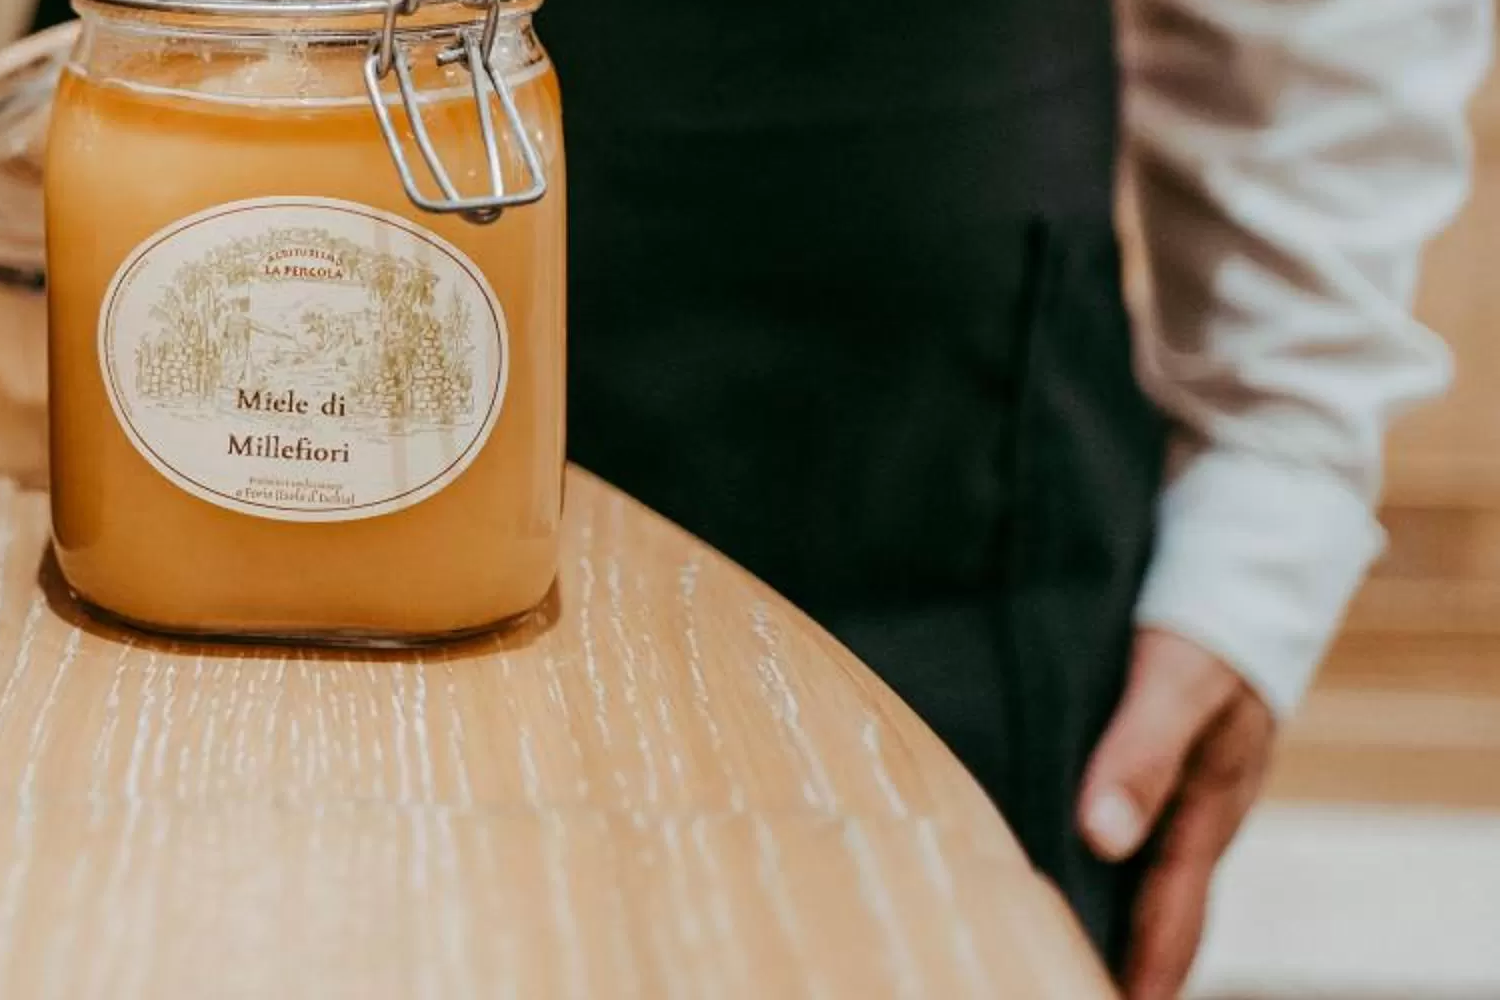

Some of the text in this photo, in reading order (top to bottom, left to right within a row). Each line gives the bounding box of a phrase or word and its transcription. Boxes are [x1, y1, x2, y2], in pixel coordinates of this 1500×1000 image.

[264, 264, 344, 280] LA PERGOLA
[236, 388, 346, 417] Miele di
[227, 433, 350, 463] Millefiori
